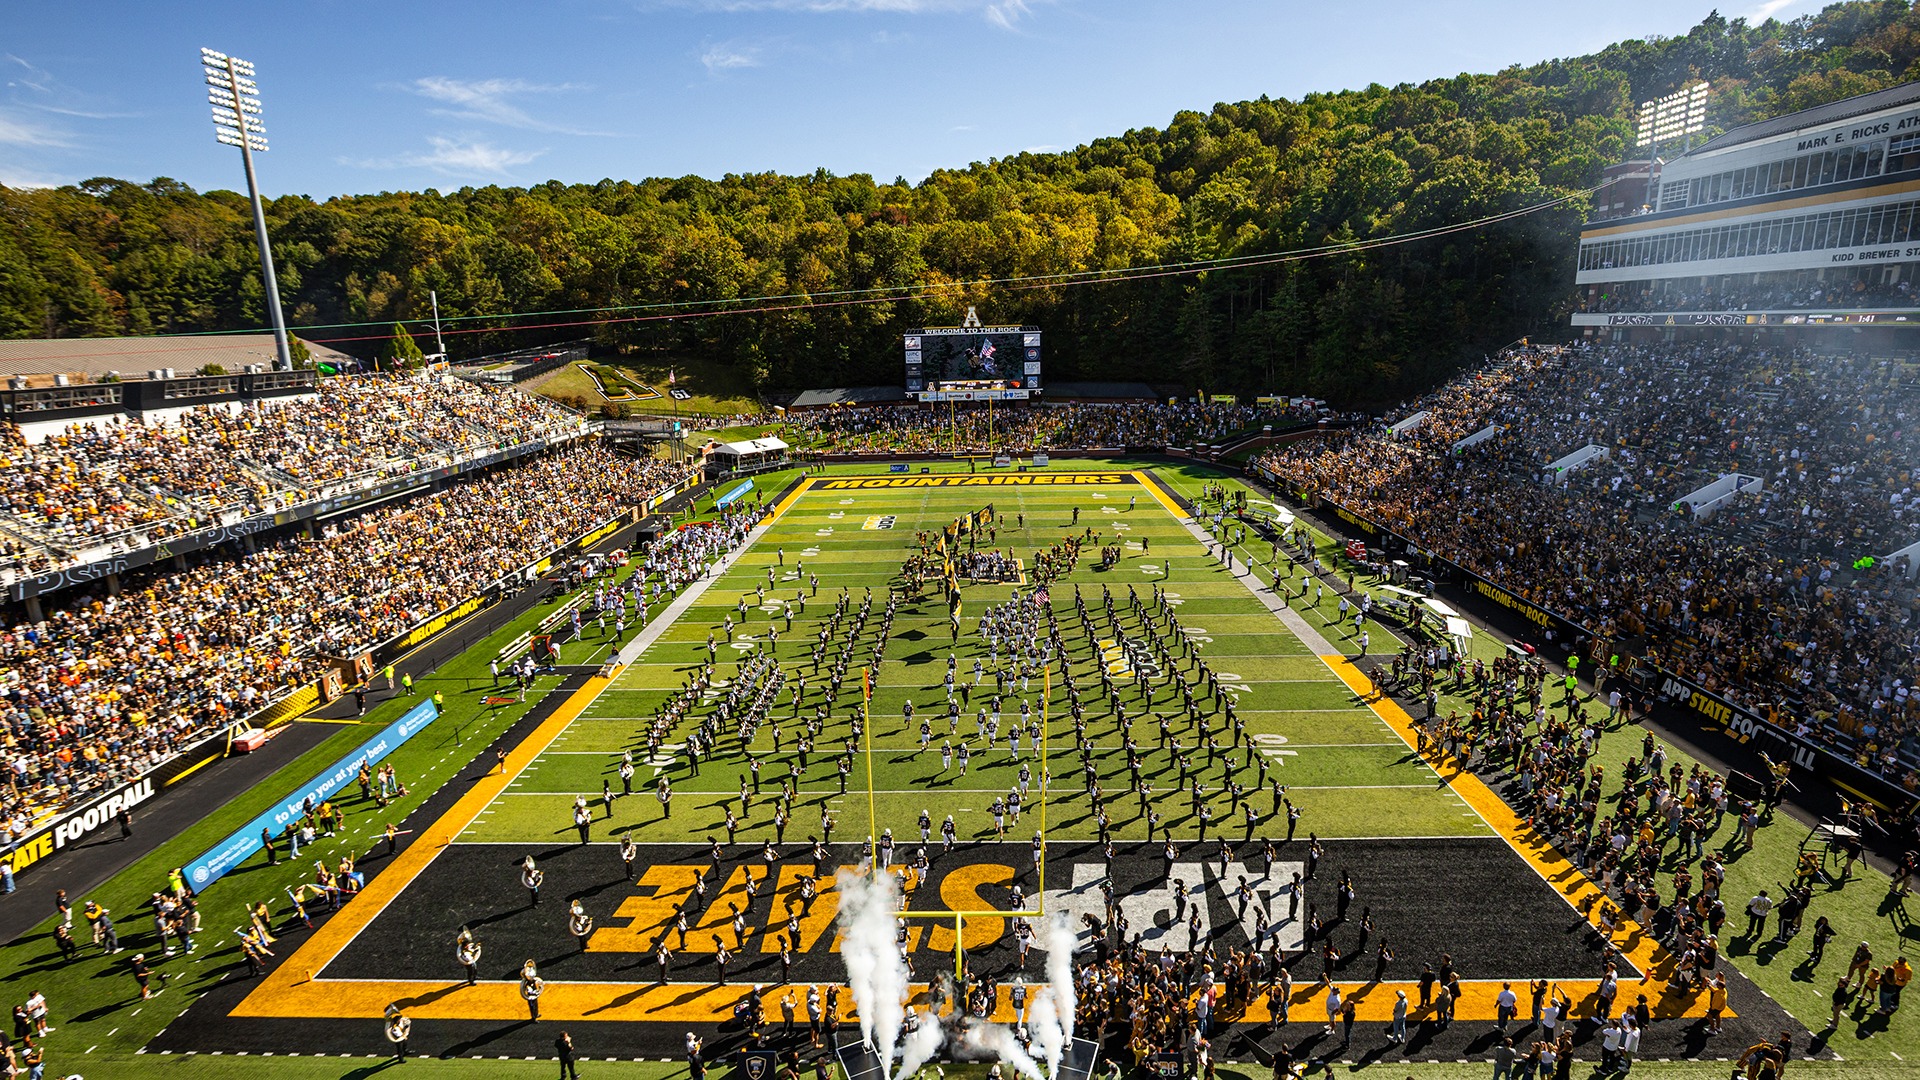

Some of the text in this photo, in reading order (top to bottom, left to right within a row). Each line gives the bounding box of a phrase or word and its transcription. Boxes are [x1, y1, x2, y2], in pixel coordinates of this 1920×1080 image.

[1797, 136, 1829, 151] MARK
[1834, 132, 1845, 144] E.
[1851, 122, 1890, 140] RICKS
[1831, 253, 1855, 262] KIDD
[1859, 249, 1901, 260] BREWER
[1858, 315, 1876, 323] 1:41
[822, 475, 1122, 490] MOUNTAINEERS
[1478, 581, 1550, 627] WELCOME TO THE ROCK
[409, 614, 447, 646] WELCOME
[459, 598, 478, 618] ROCK
[1661, 678, 1691, 702] APP
[1689, 692, 1732, 725] STATE
[1252, 733, 1299, 757] 10
[275, 811, 290, 824] to
[315, 778, 336, 798] you
[334, 767, 348, 782] at
[346, 754, 367, 776] your
[366, 740, 388, 759] best
[0, 778, 155, 879] ATE FOOTBALL
[1013, 897, 1019, 905] 3
[1022, 862, 1305, 952] APP
[1014, 992, 1025, 1001] 90
